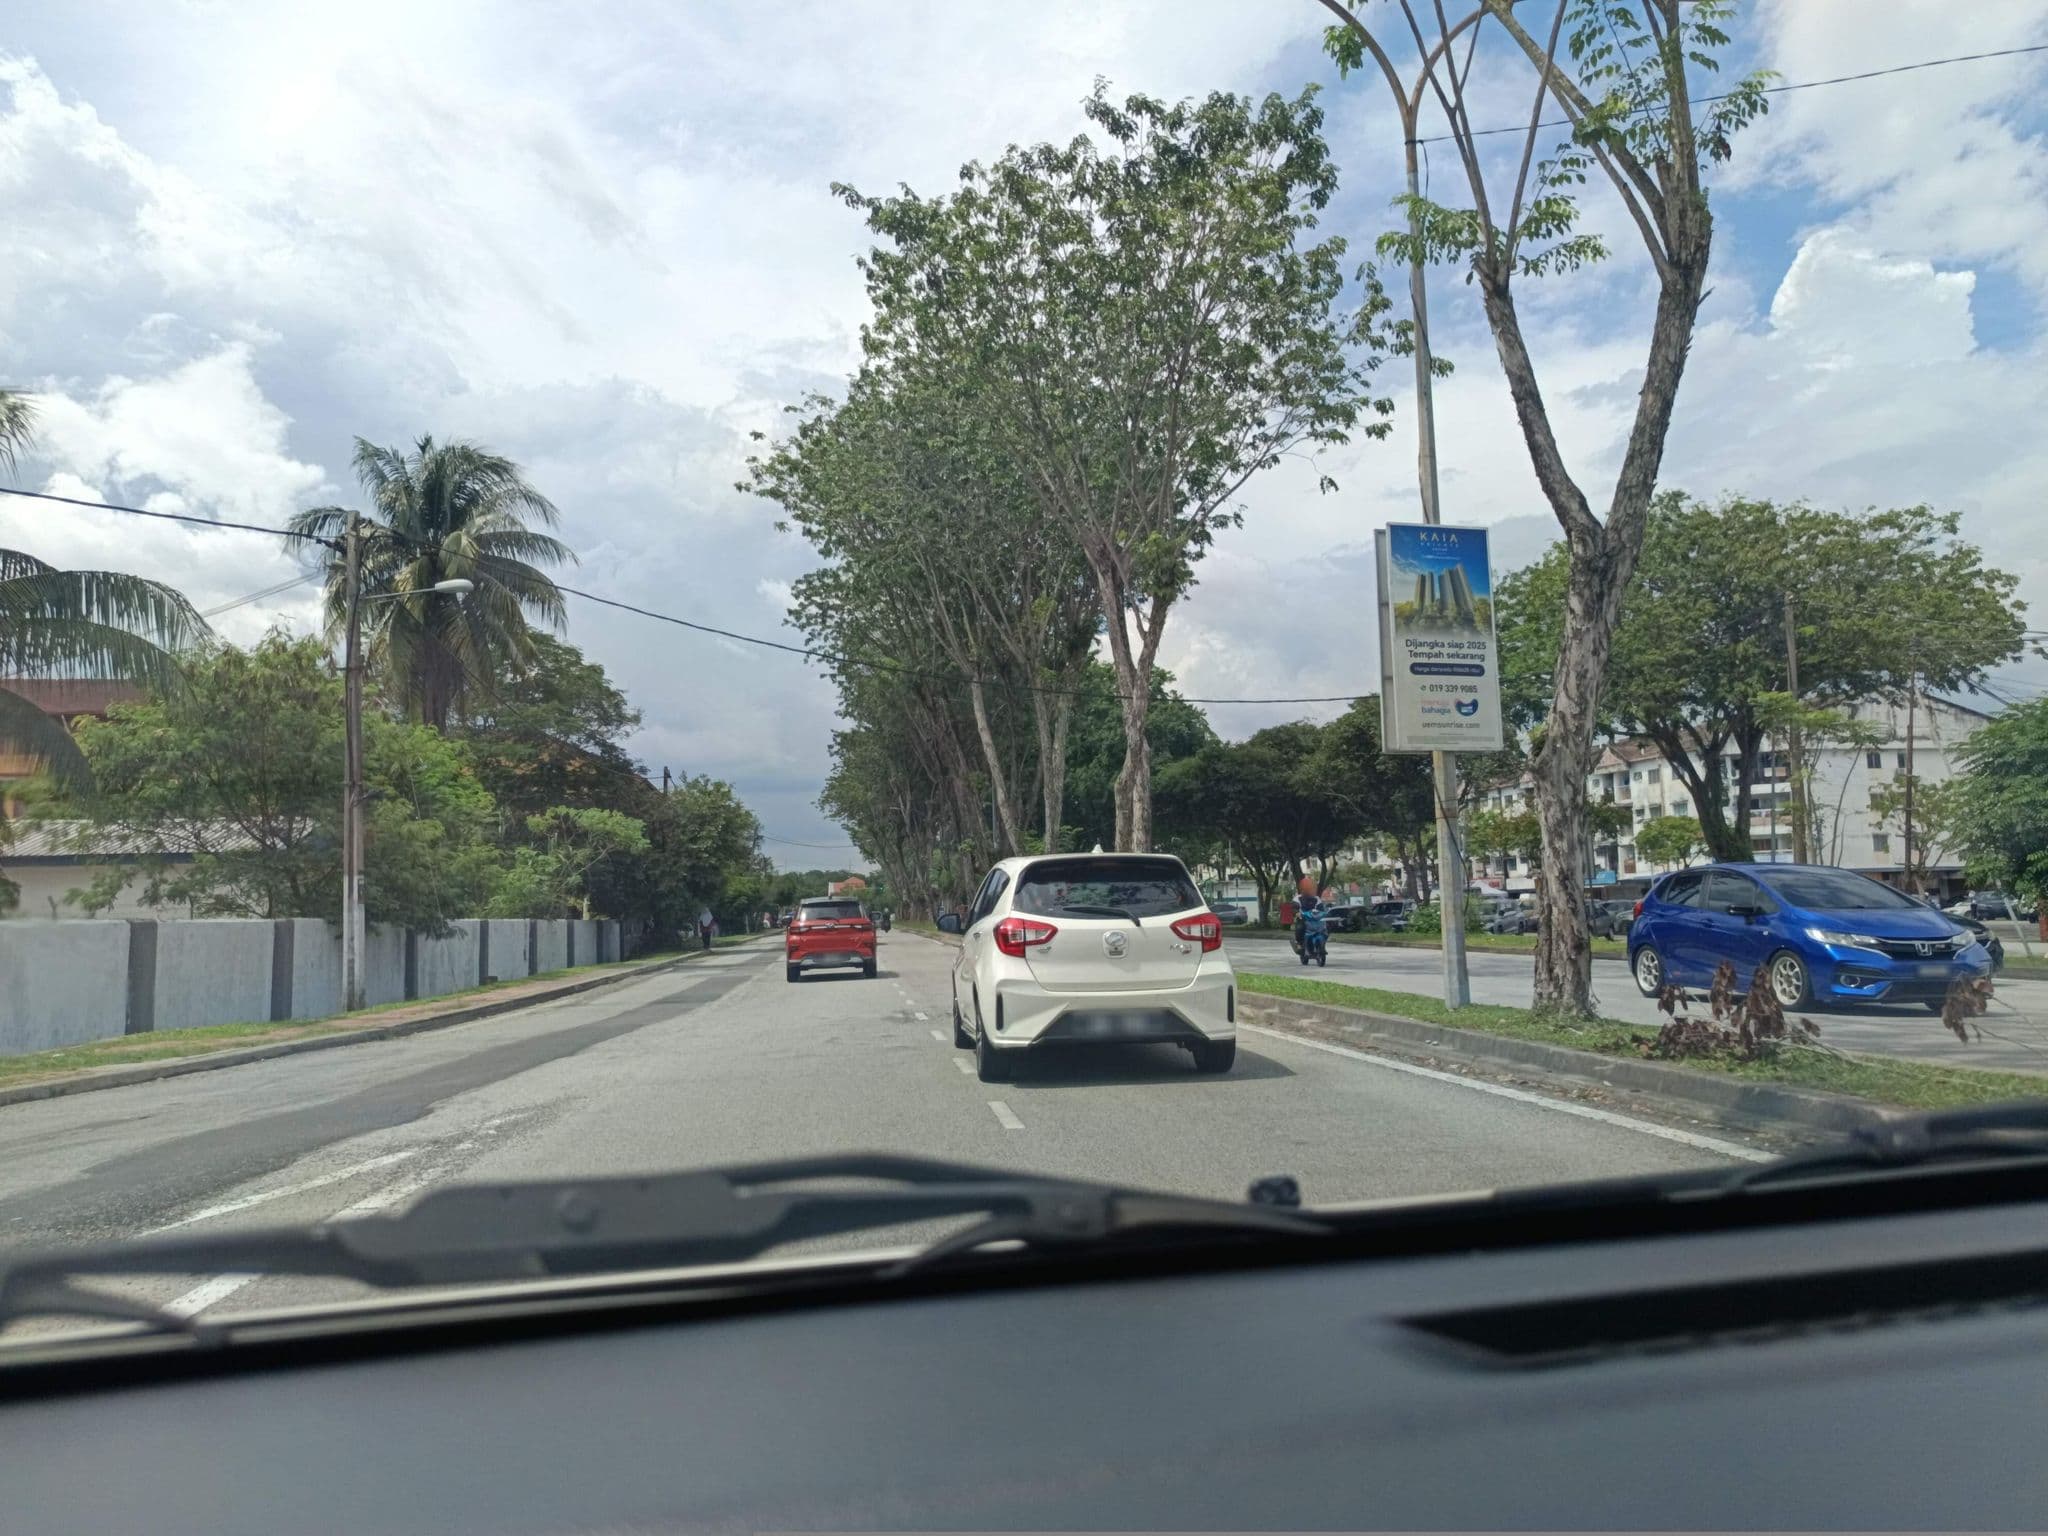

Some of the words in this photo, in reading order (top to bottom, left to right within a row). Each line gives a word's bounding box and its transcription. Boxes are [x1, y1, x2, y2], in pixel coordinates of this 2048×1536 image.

[1420, 532, 1458, 543] KAIA
[1405, 639, 1445, 649] Dijangka
[1447, 640, 1465, 650] siap
[1466, 641, 1487, 650] 2025
[1408, 650, 1445, 660] Tempah
[1446, 651, 1485, 662] sekarang
[1429, 684, 1443, 692] 019
[1444, 685, 1459, 693] 339
